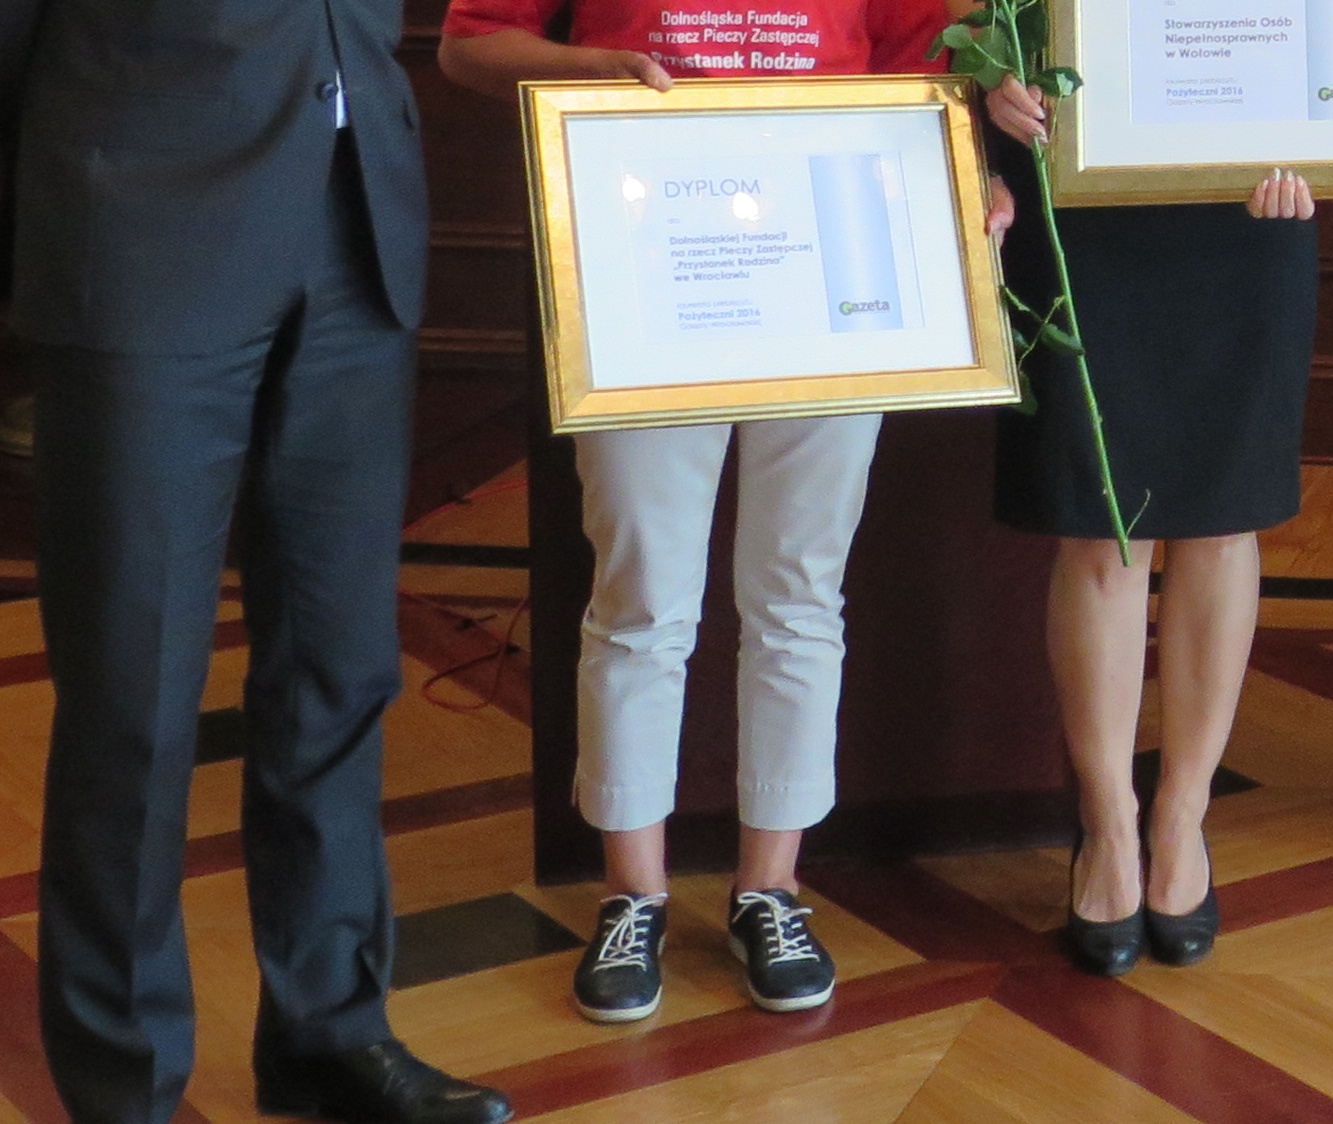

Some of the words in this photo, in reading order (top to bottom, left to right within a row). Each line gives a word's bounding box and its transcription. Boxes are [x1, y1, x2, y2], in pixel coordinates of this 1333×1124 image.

[661, 10, 743, 27] Dolnośląska
[747, 10, 808, 28] Fundacja
[1164, 17, 1257, 30] Stowarzyszenia
[1260, 15, 1294, 28] Osób
[649, 32, 662, 43] na
[666, 32, 700, 43] rzecz
[704, 28, 748, 45] Pieczy
[751, 28, 820, 47] Zastępczej
[751, 51, 816, 70] Rodzina
[664, 178, 762, 199] DYPLOM
[839, 299, 891, 316] Gazeta
